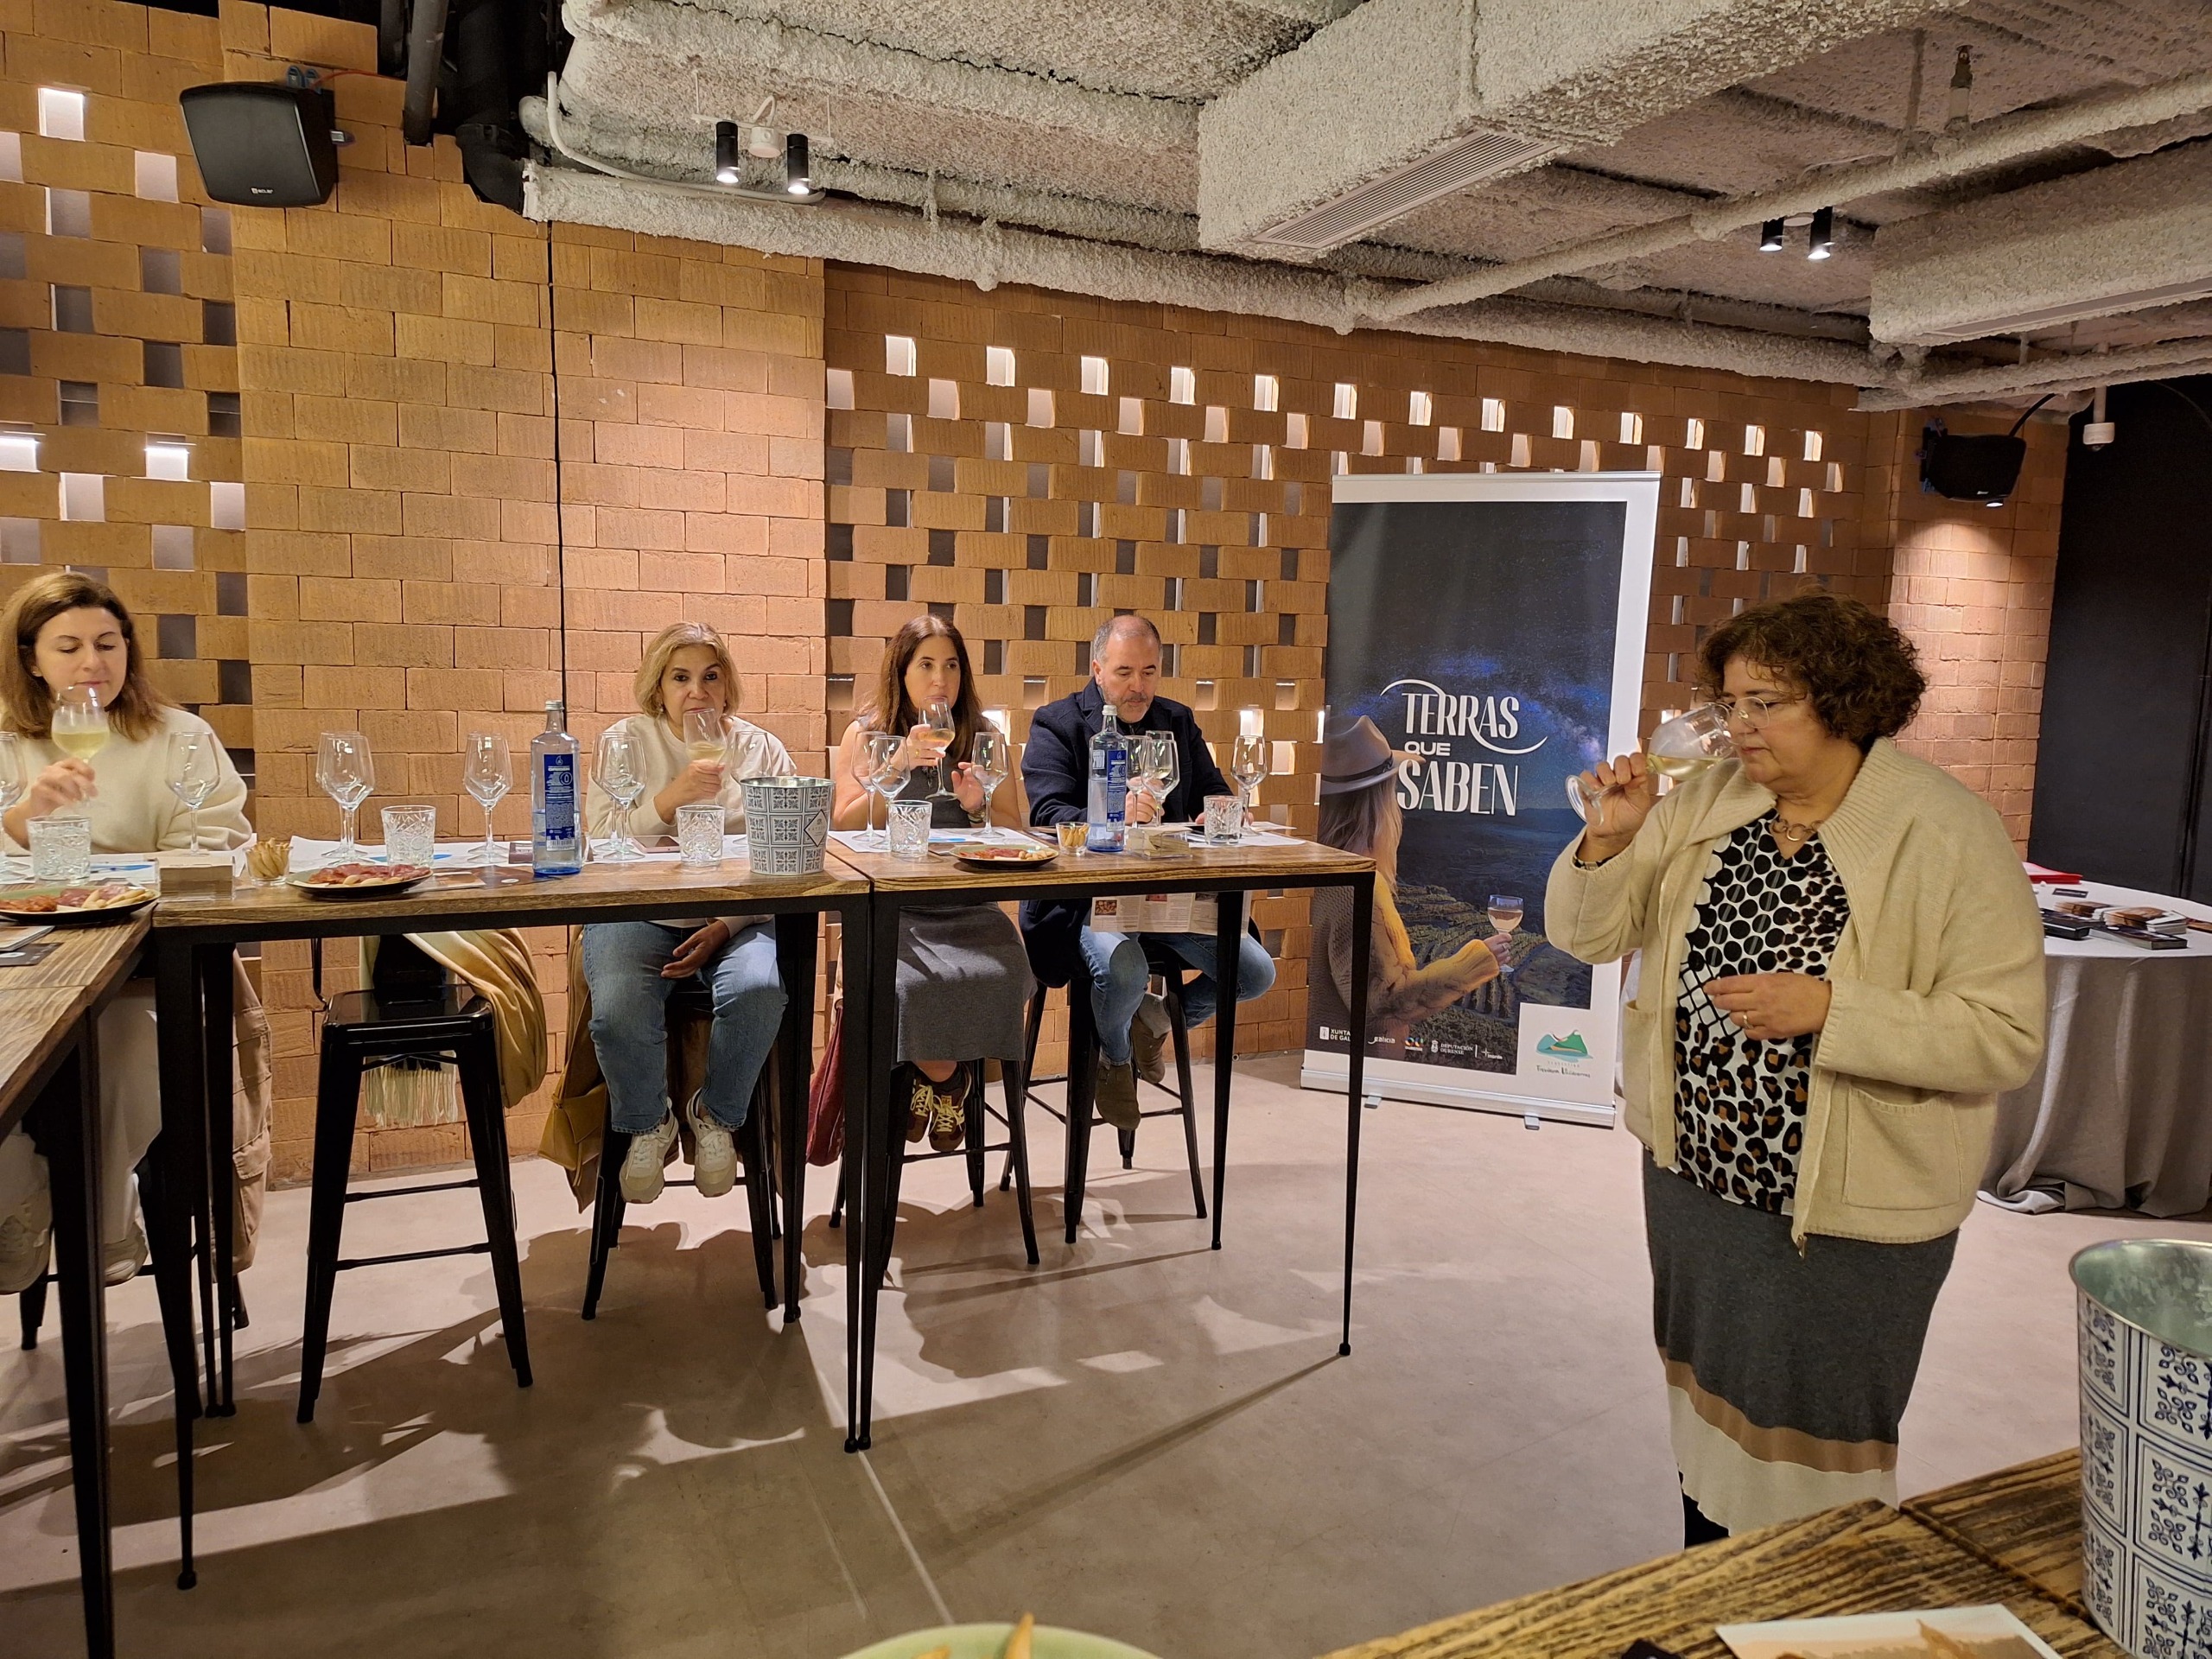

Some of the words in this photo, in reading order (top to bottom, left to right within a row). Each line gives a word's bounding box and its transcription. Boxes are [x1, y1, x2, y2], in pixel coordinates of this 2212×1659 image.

[1401, 692, 1521, 740] TERRAS
[1403, 741, 1451, 757] QUE
[1396, 759, 1518, 817] SABEN
